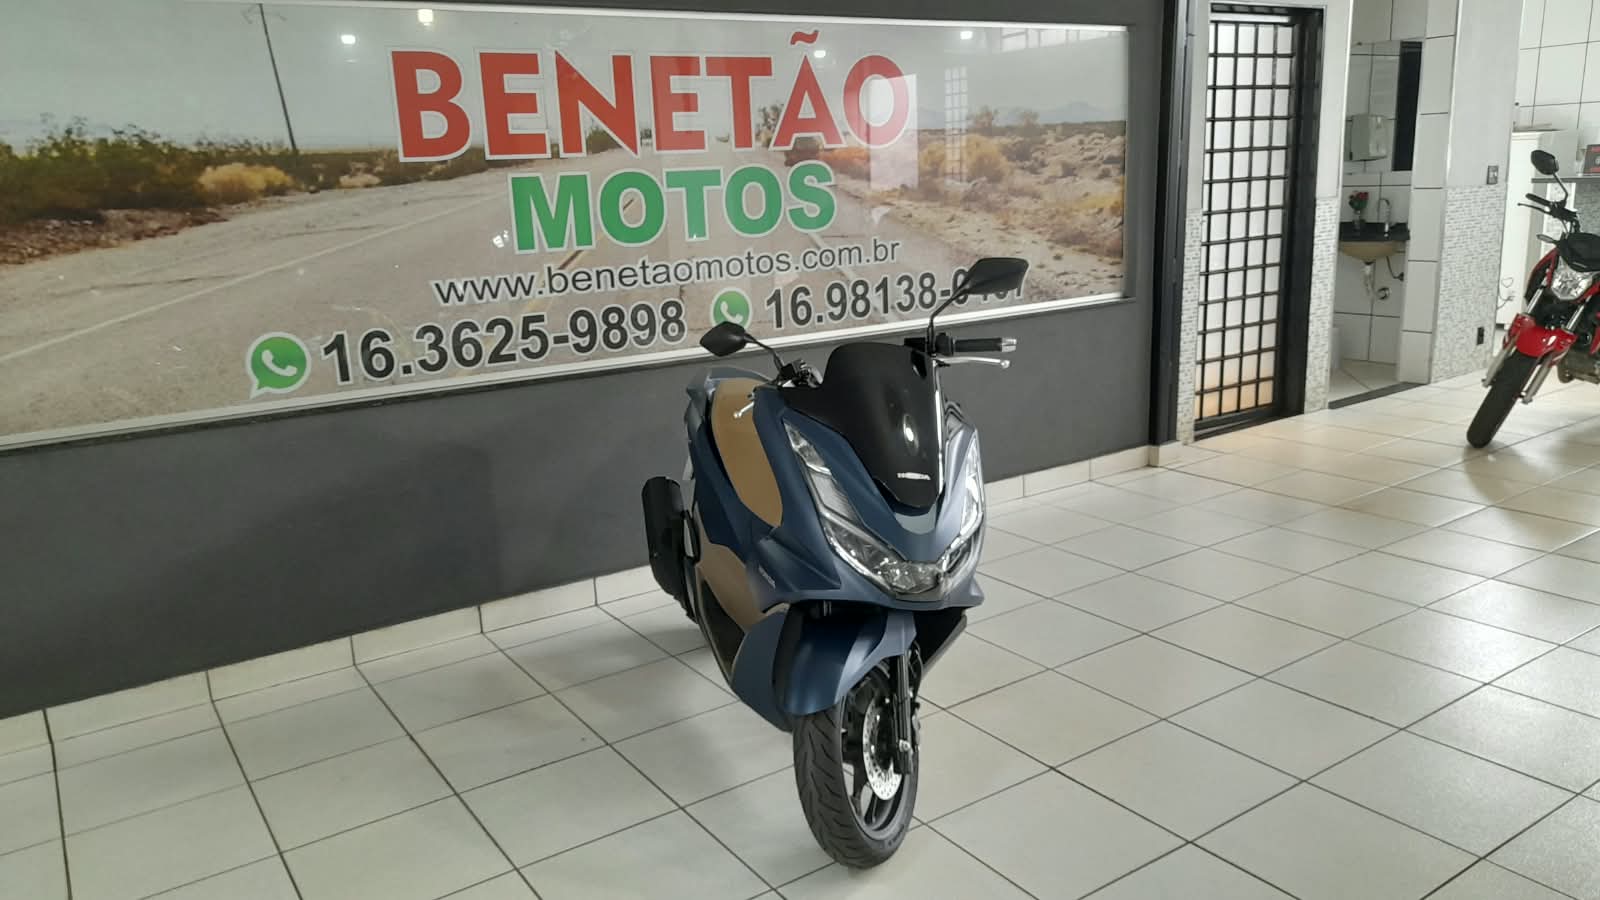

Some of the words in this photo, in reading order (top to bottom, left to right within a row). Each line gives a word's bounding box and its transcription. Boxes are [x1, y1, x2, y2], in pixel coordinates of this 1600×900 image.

[390, 31, 910, 159] BENETÃO
[511, 165, 837, 251] MOTOS
[434, 238, 900, 304] www.benetaomotos.com.br
[322, 300, 686, 383] 16.3625-9898
[765, 266, 1027, 329] 16.98138-0
